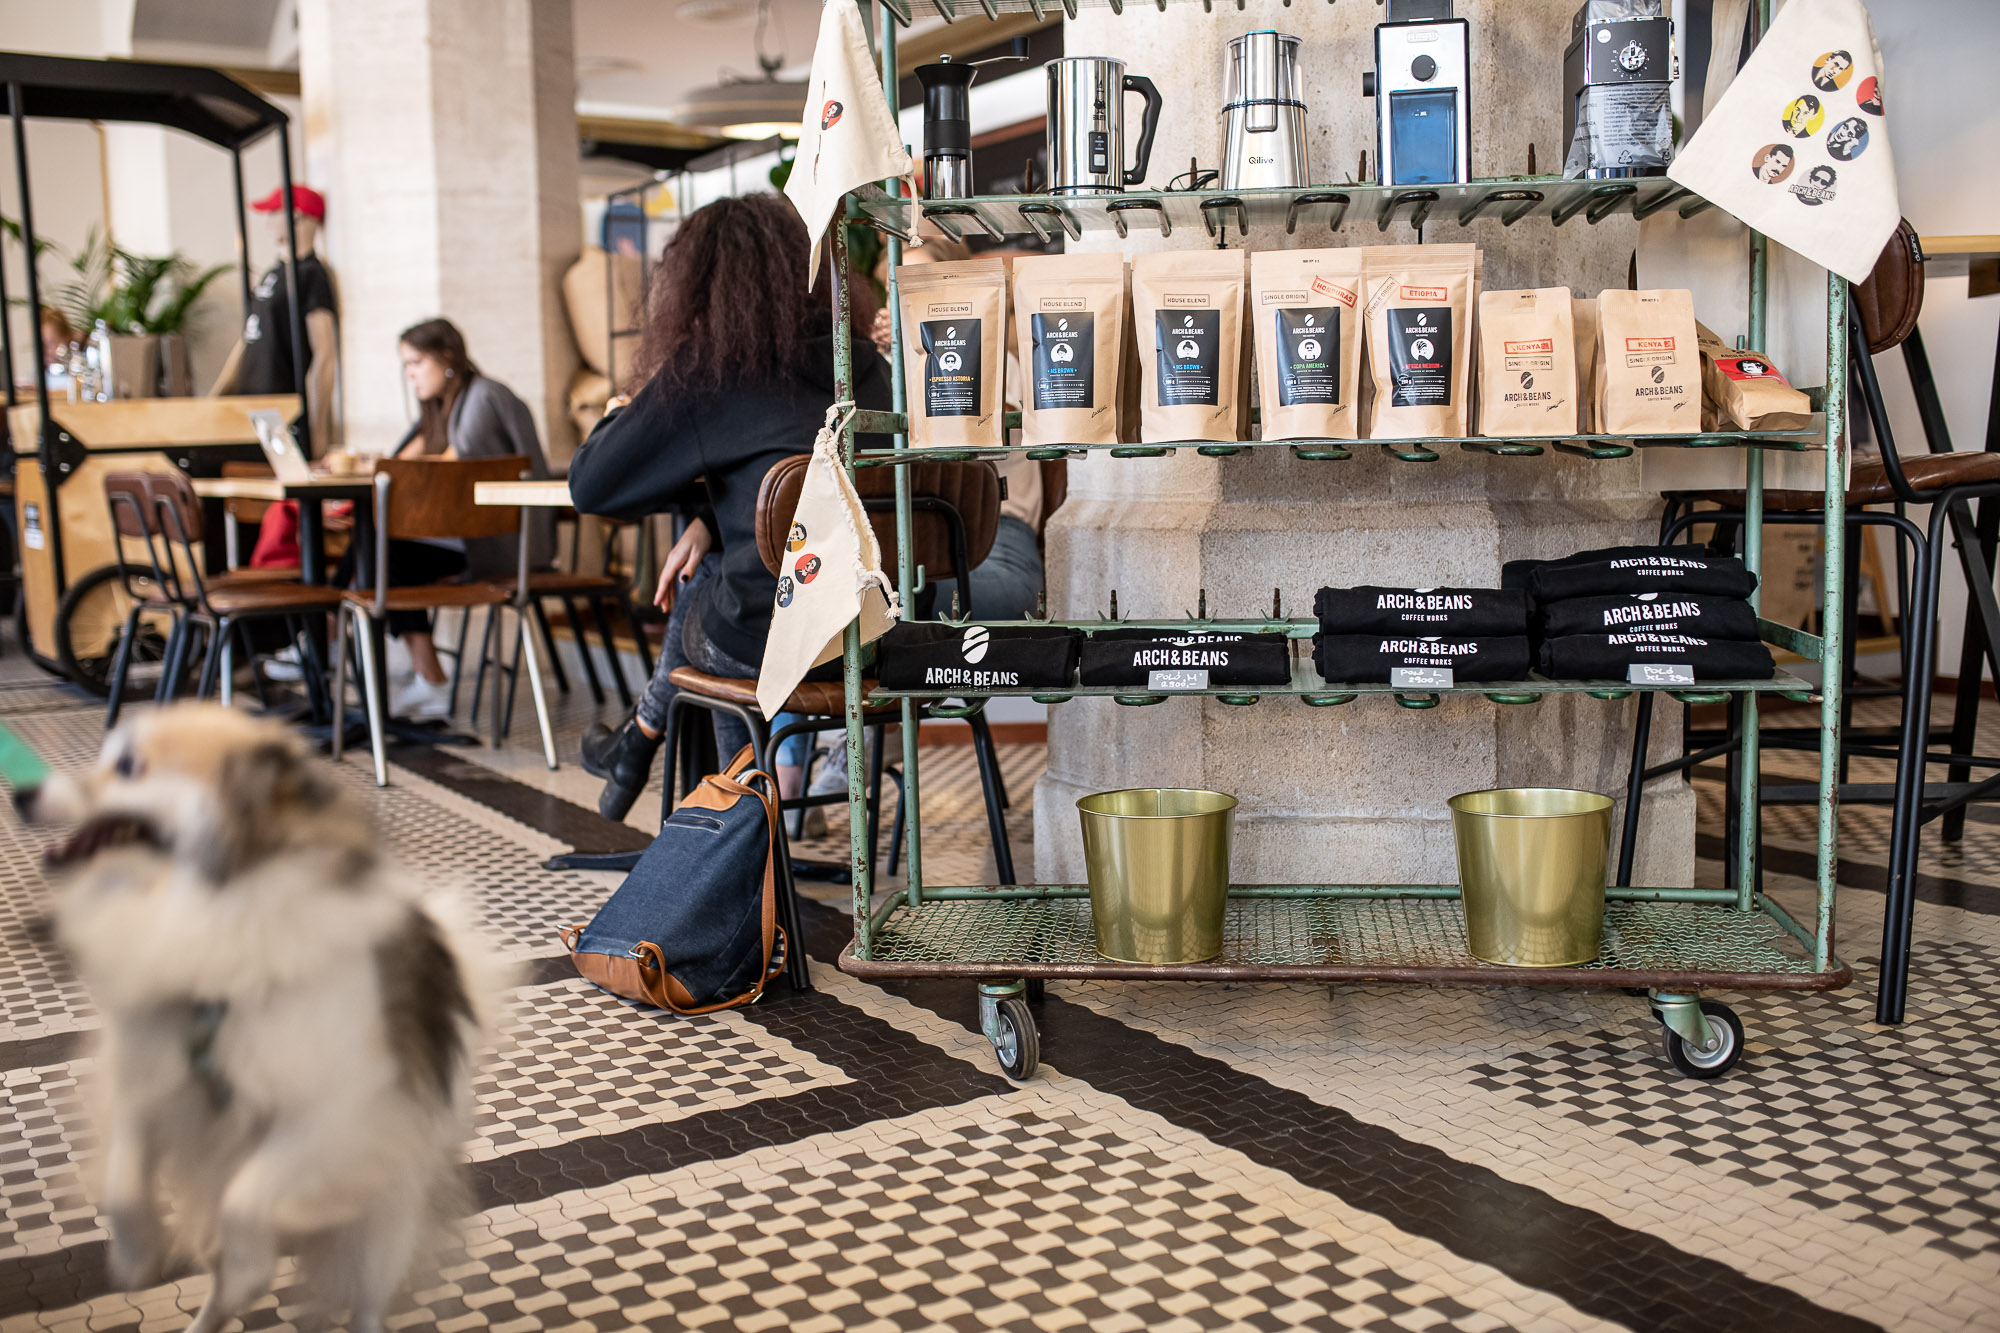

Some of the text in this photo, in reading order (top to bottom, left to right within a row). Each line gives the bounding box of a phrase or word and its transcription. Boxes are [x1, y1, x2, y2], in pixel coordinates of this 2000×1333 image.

[1248, 156, 1274, 165] Qilive
[1788, 184, 1837, 201] ARCH&BEANS
[1316, 282, 1354, 304] HONDURAS
[1409, 289, 1438, 297] ETIOPIA
[1046, 331, 1079, 339] ARCH&BEANS
[1292, 326, 1326, 334] ARCH&BEANS
[1405, 326, 1438, 334] ARCH&BEANS
[934, 339, 967, 347] ARCH&BEANS
[1516, 343, 1540, 351] KENYA
[1504, 391, 1552, 402] ARCH&BEANS
[1635, 385, 1684, 397] ARCH&BEANS
[1610, 556, 1708, 569] ARCH&BEANS
[1376, 594, 1473, 610] ARCH&BEANS
[1401, 613, 1425, 621] COFFEE
[1603, 601, 1701, 626] ARCH&BEANS
[1629, 622, 1678, 633] COFFEE WORKS
[1608, 633, 1708, 646] ARCH&BEANS
[1380, 639, 1478, 655] ARCH&BEANS
[1132, 649, 1229, 667] ARCH&BEANS
[1403, 657, 1453, 666] COFFEE WORKS
[924, 667, 1019, 686] ARCH&BEANS
